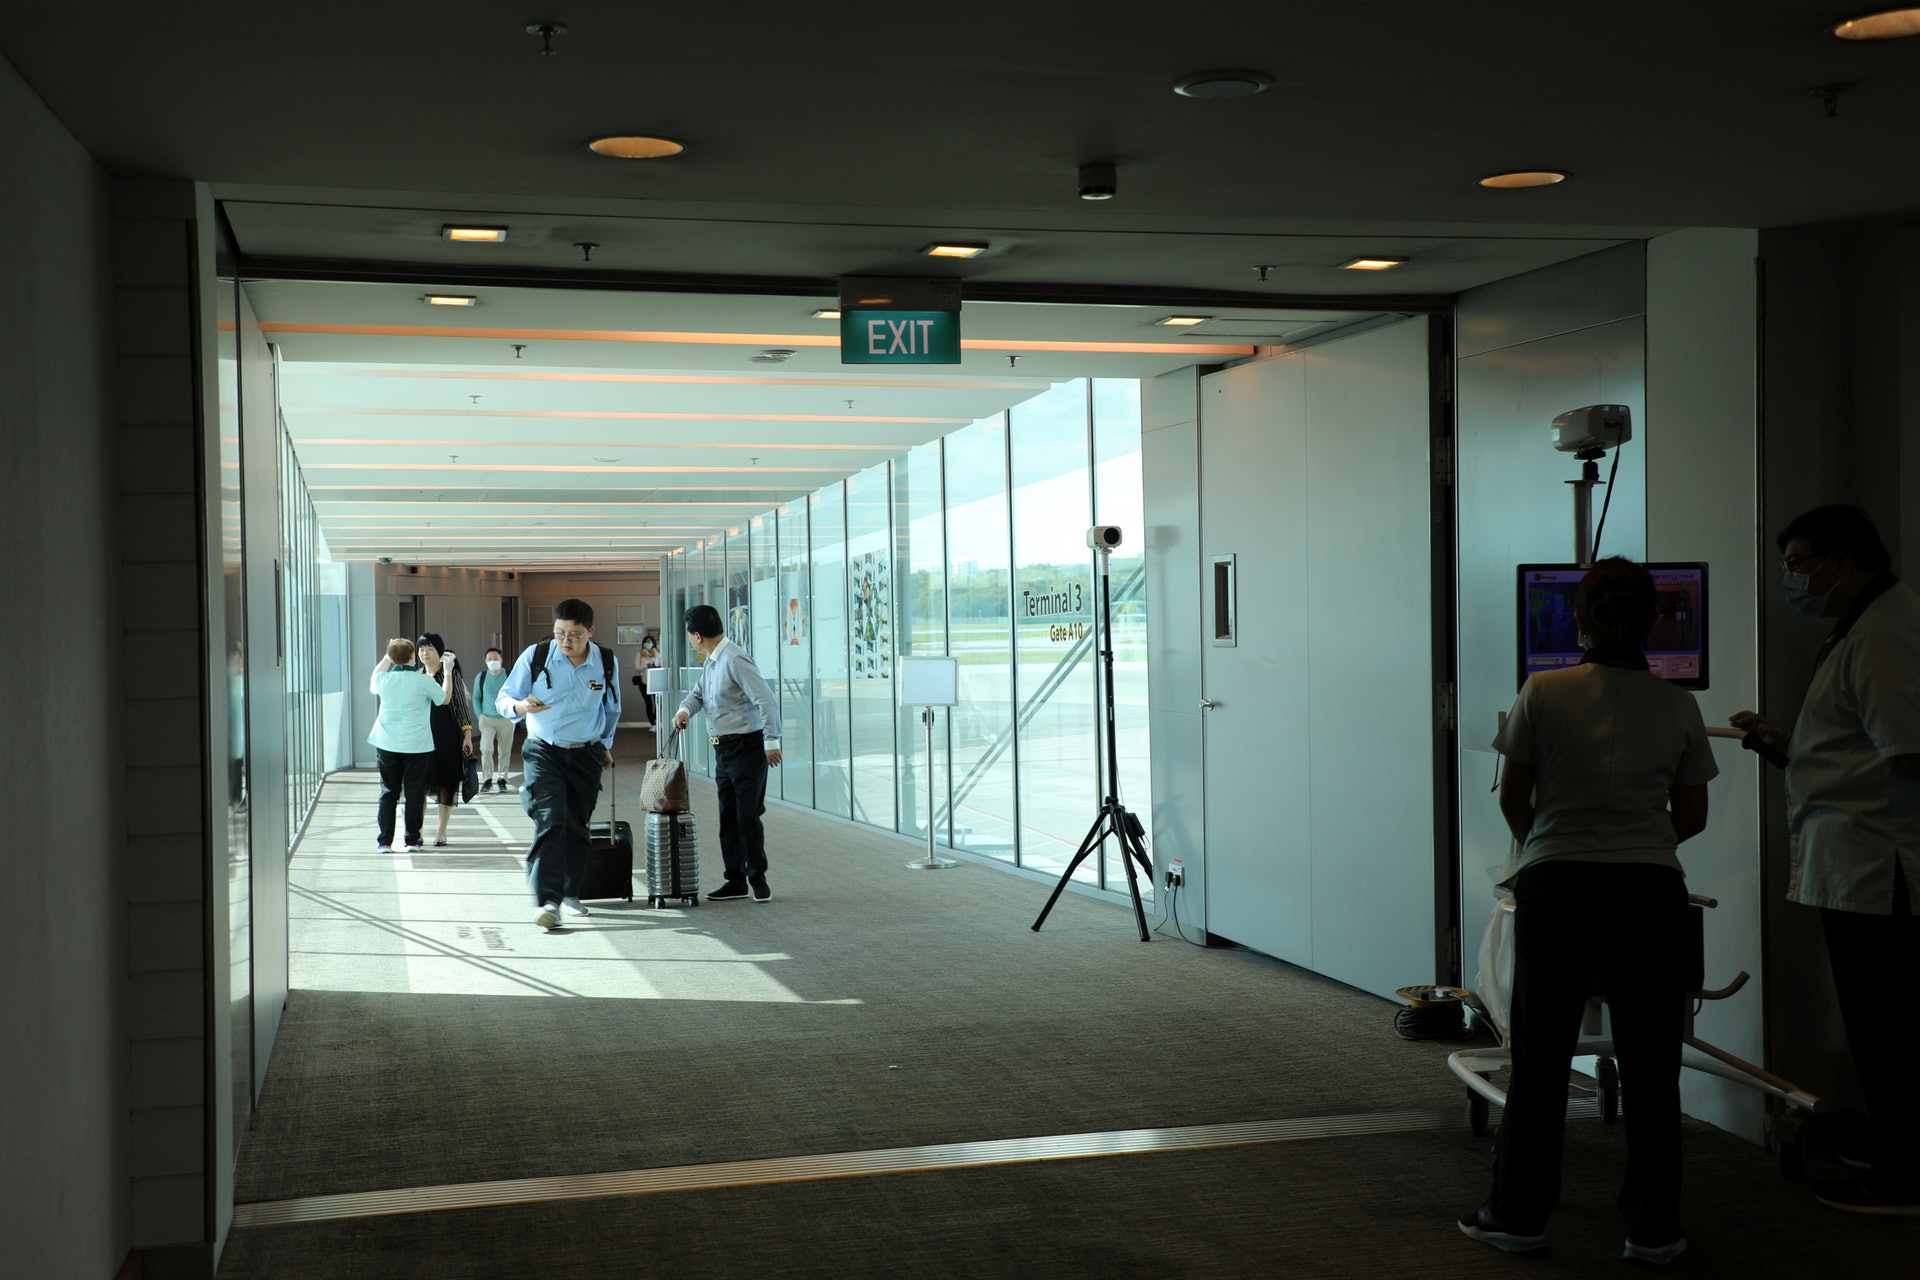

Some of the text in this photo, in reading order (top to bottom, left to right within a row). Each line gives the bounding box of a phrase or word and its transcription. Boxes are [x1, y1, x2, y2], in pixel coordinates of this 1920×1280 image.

[868, 320, 934, 354] EXIT
[1023, 583, 1082, 617] Terminal 3
[1050, 622, 1083, 642] Gate A10
